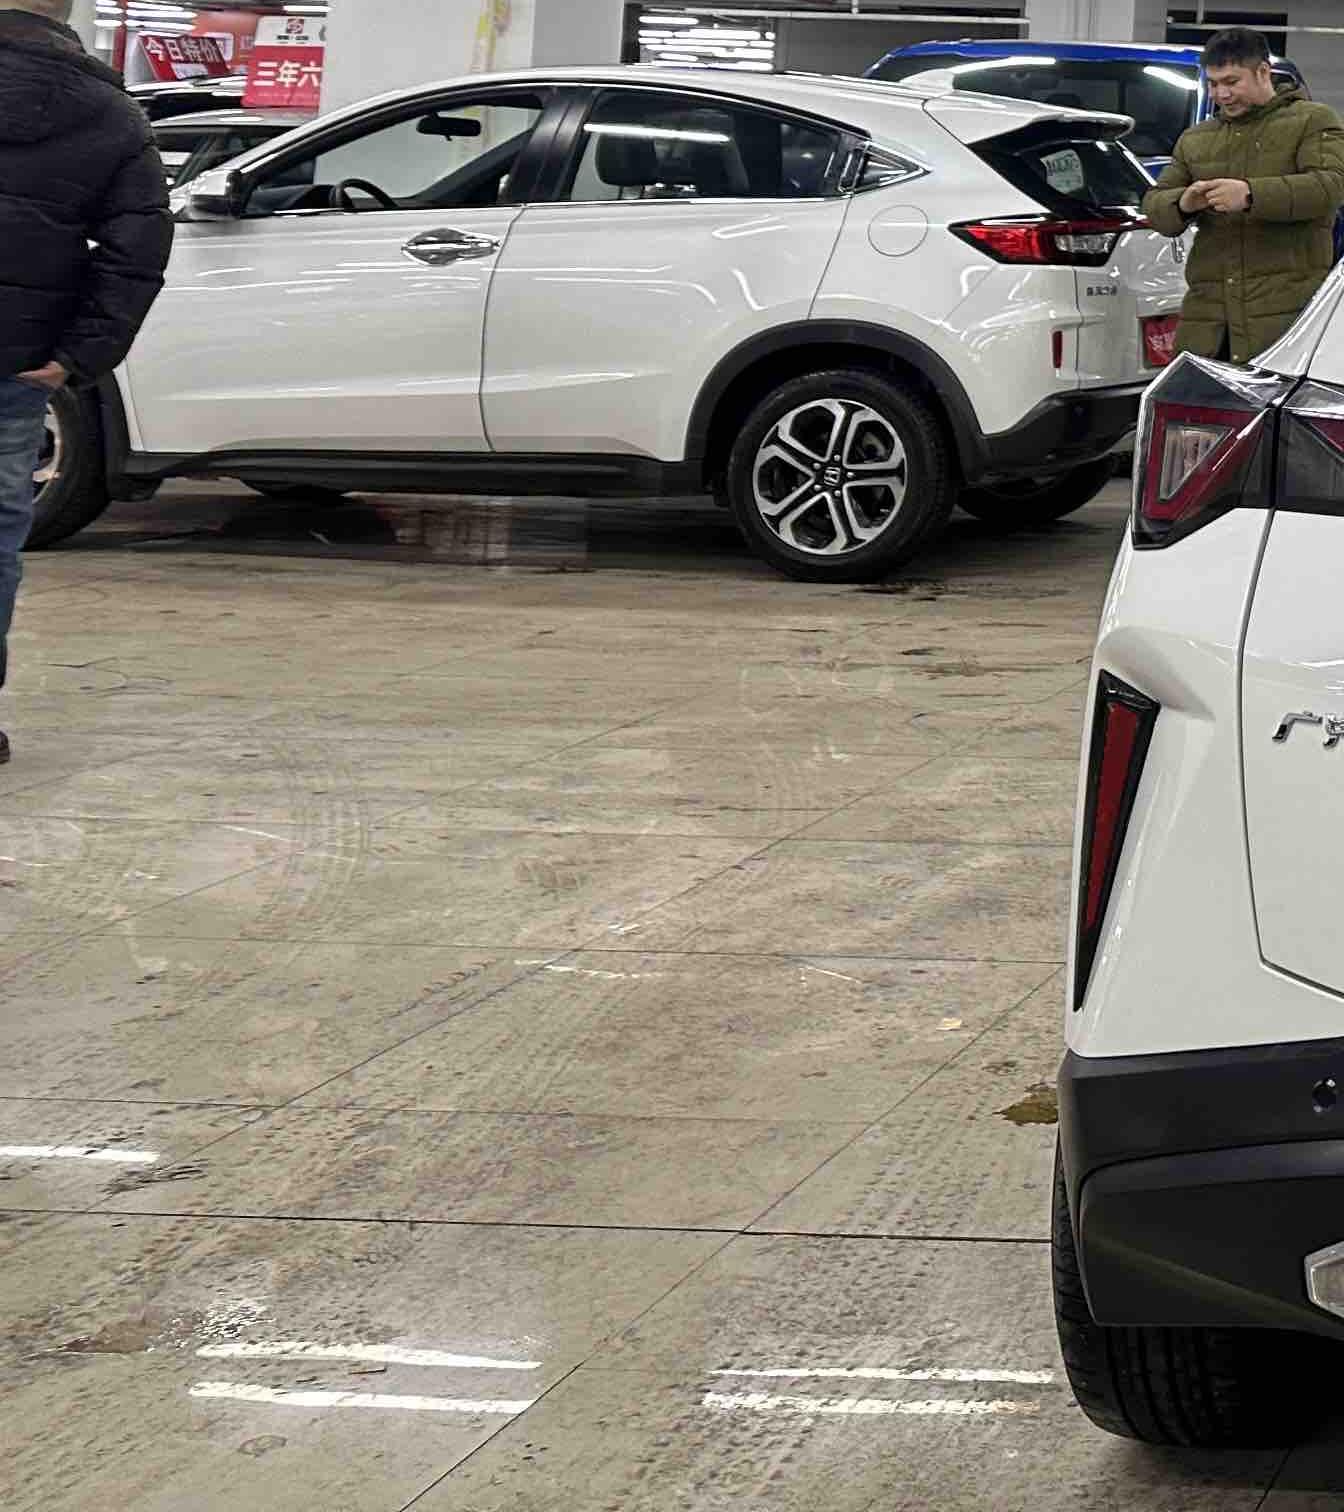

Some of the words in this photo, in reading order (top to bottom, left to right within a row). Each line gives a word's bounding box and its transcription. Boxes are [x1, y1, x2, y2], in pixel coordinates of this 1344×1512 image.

[146, 37, 219, 63] 今日特价
[252, 60, 322, 87] 三年六
